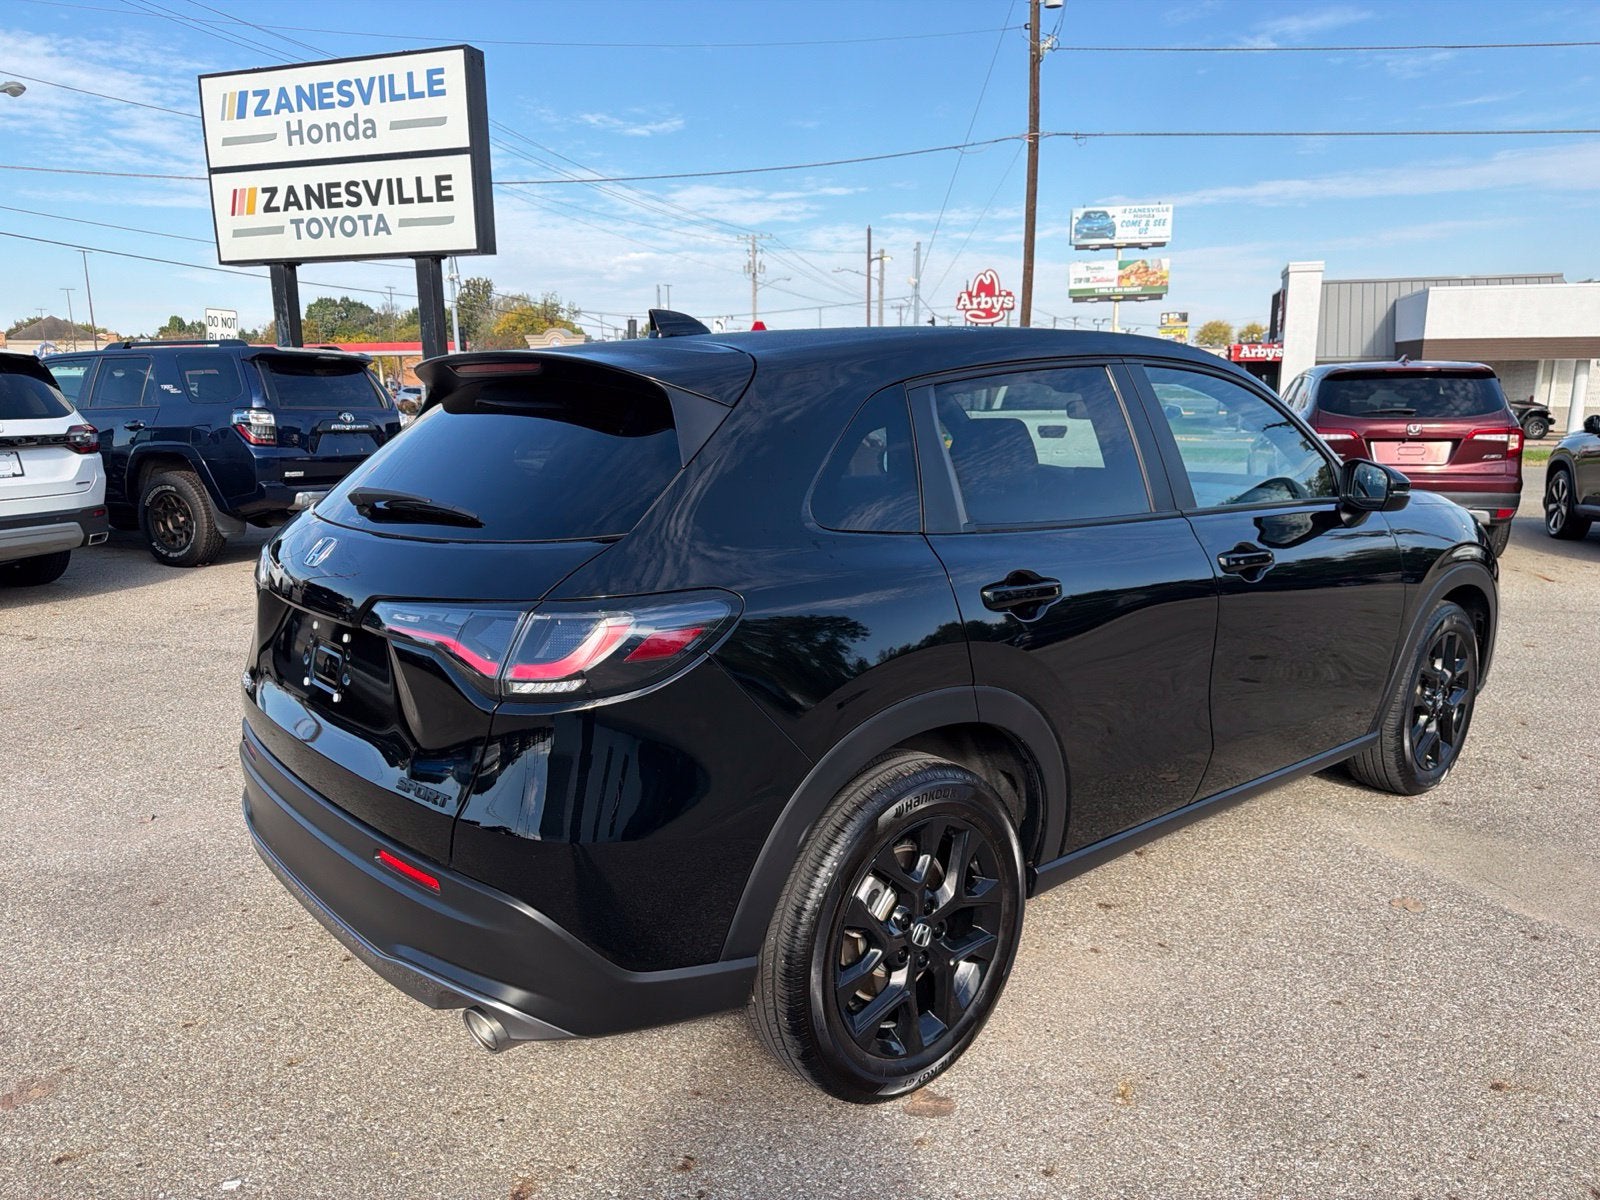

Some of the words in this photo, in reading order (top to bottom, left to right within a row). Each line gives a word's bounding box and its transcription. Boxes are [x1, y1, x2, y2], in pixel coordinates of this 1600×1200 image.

[253, 67, 447, 117] ZANESVILLE
[286, 113, 377, 147] Honda
[261, 174, 454, 214] ZANESVILLE
[290, 213, 392, 241] TOYOTA
[1120, 220, 1142, 228] COME
[1153, 218, 1167, 227] SEE
[1138, 227, 1149, 235] US
[957, 292, 1014, 313] Arby's
[207, 315, 219, 327] DO
[221, 317, 236, 329] NOT
[1239, 344, 1283, 361] Arby's
[396, 776, 452, 807] SPORT
